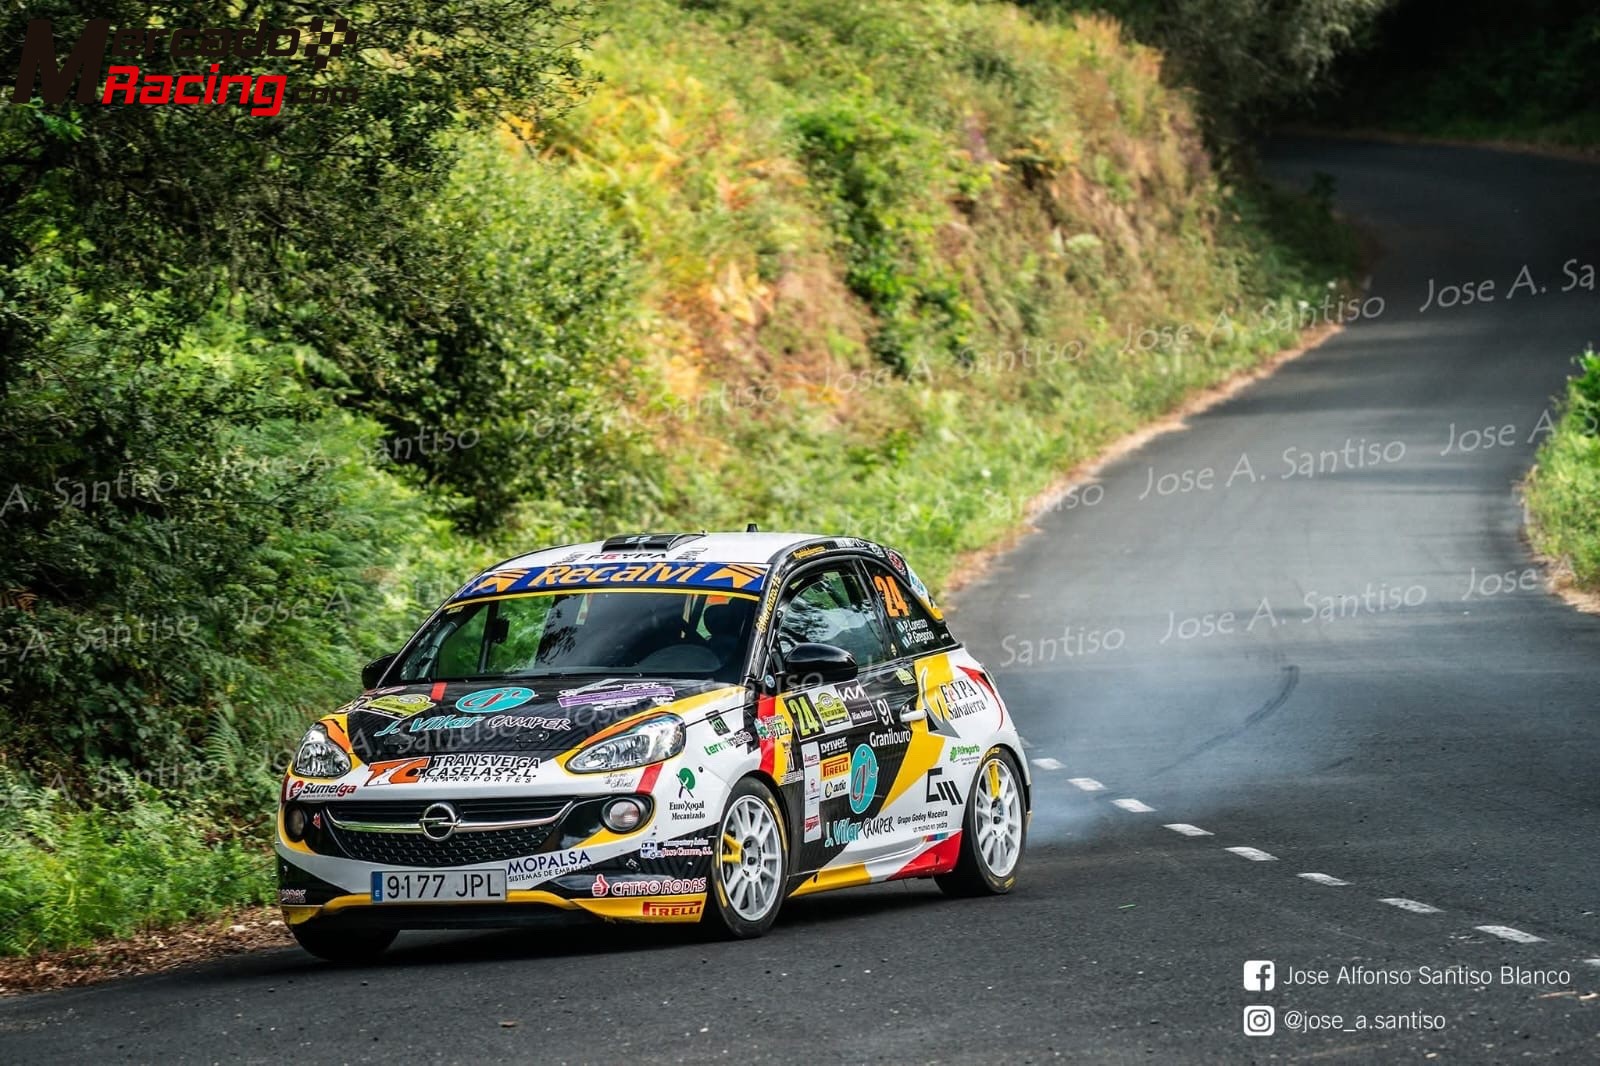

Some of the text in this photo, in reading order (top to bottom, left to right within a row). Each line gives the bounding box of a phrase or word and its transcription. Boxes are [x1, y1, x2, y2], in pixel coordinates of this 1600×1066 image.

[527, 561, 705, 588] Recalvi
[872, 574, 911, 618] 24
[787, 695, 820, 737] 24
[946, 699, 987, 721] Salvaterra
[409, 714, 486, 733] Vilar
[487, 714, 572, 731] CAMPER
[432, 753, 542, 769] TRANSVEIGA
[823, 756, 849, 777] PIRELLI
[302, 782, 357, 798] Sumelga
[832, 818, 862, 846] Vilar
[862, 815, 896, 839] CAMPER
[507, 850, 592, 876] MOPALSA
[386, 872, 501, 899] 9177 JPL
[508, 872, 542, 882] SISTEMAS
[641, 900, 703, 917] PIRELLI
